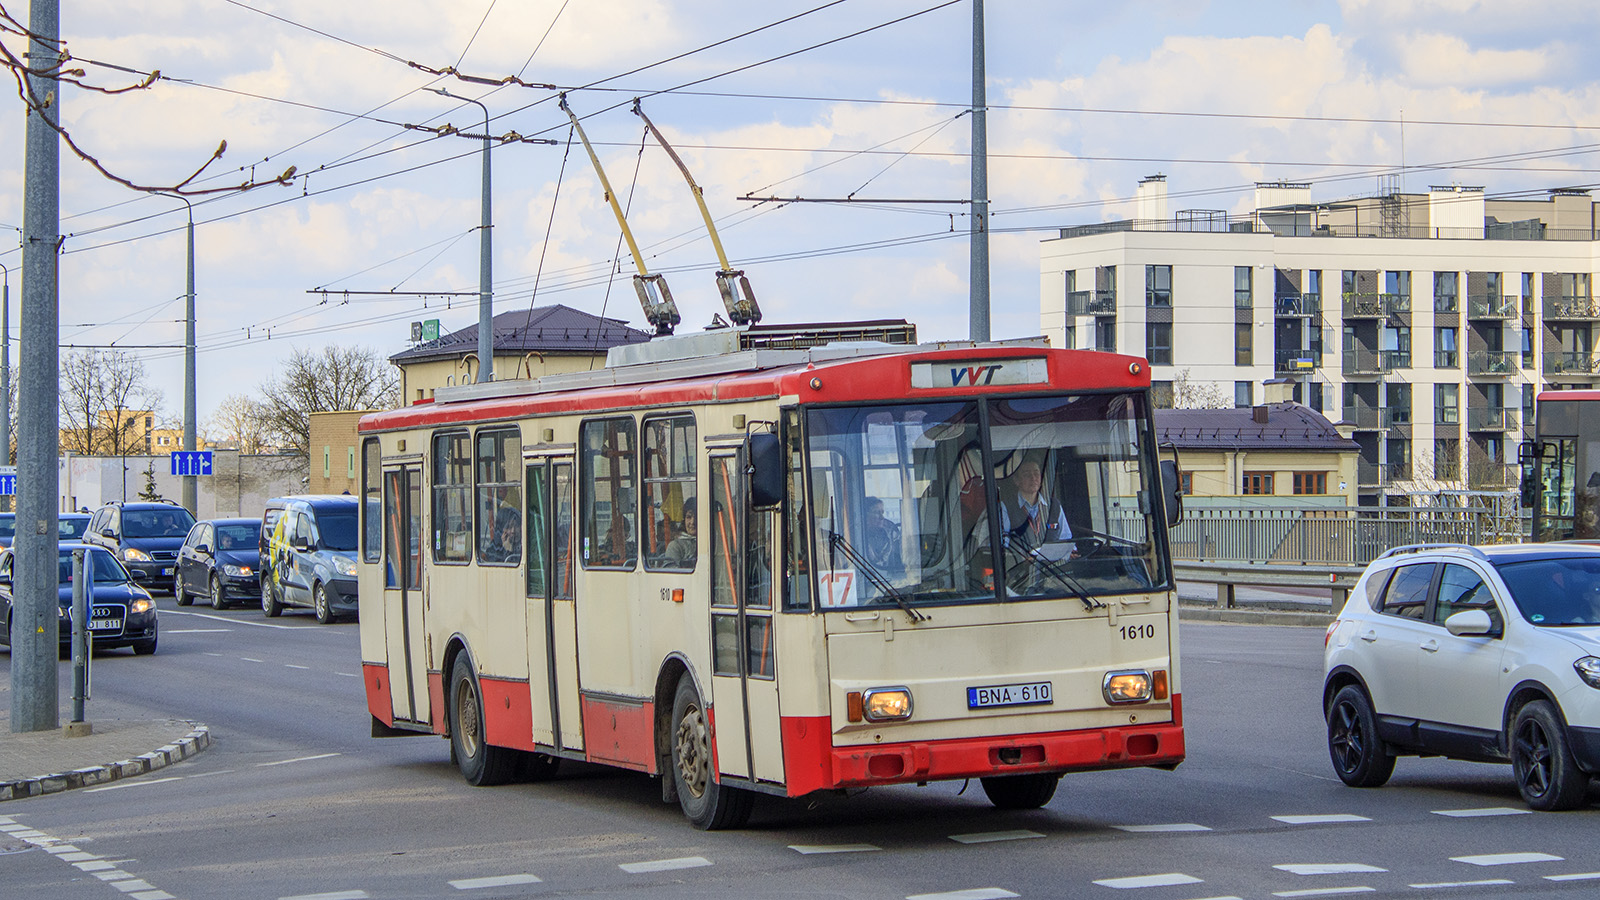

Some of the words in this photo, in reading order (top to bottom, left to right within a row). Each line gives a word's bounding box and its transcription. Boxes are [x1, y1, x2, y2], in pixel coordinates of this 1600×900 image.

[950, 364, 1003, 387] VVT
[660, 588, 671, 601] 1610
[820, 572, 854, 606] 17
[104, 620, 119, 628] 811
[1119, 624, 1155, 640] 1610
[979, 688, 1012, 705] BNA
[1021, 684, 1049, 701] 610
